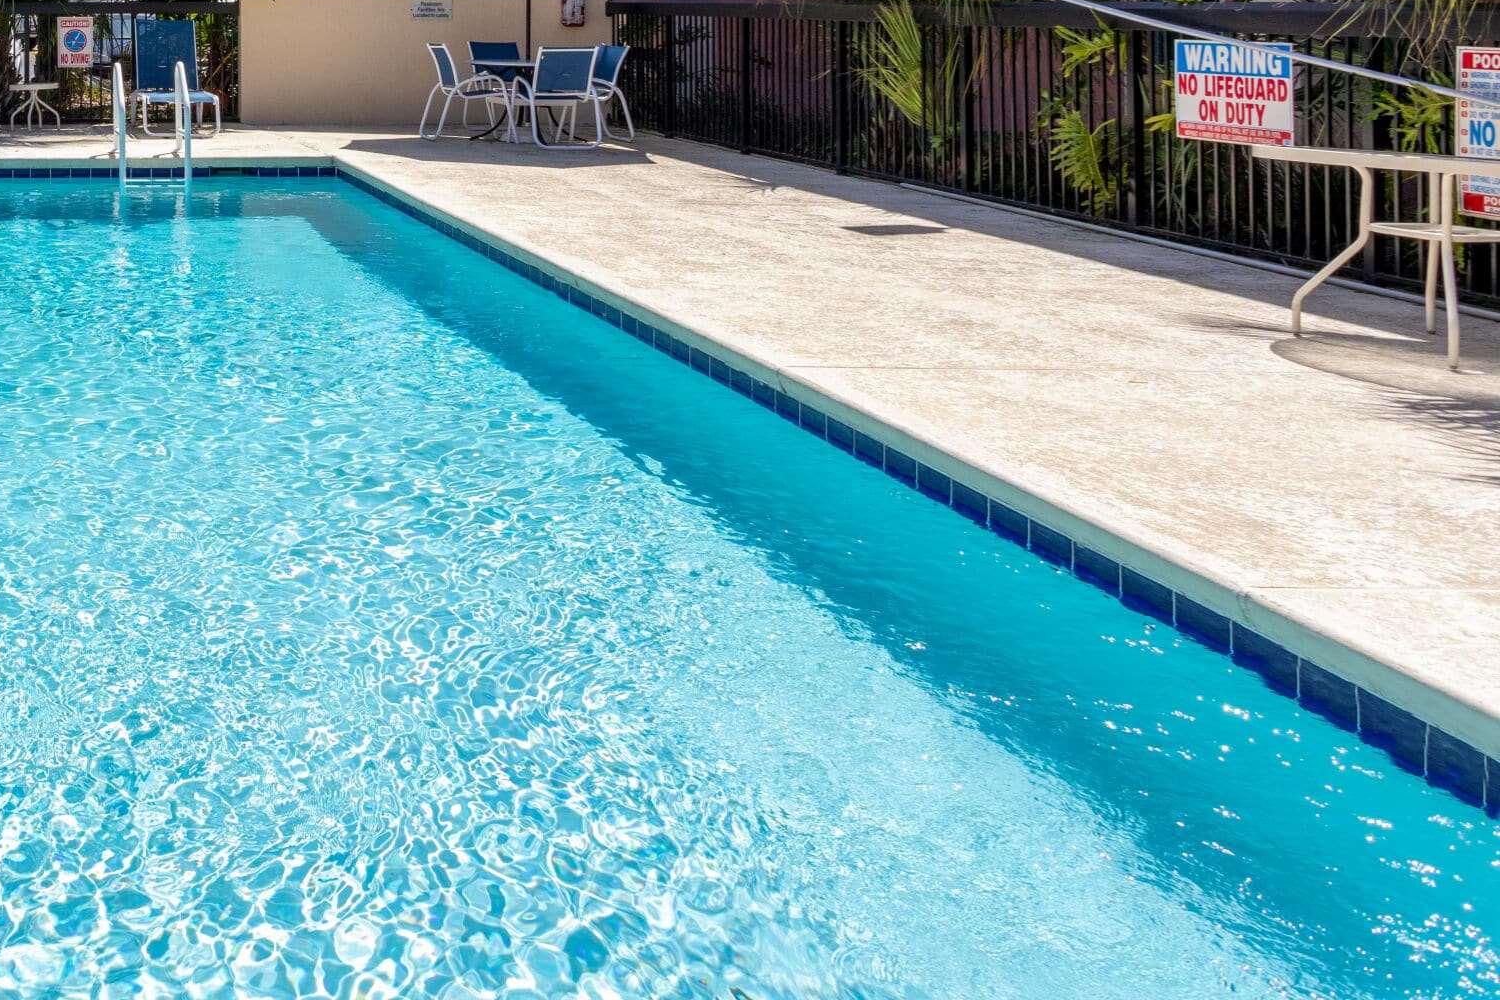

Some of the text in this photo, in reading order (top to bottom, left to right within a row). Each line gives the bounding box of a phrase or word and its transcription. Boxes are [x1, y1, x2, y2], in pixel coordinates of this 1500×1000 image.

[60, 53, 69, 65] NO
[1183, 44, 1282, 76] WARNING
[1178, 73, 1288, 103] NO LIFEGUARD
[1198, 99, 1266, 127] ON DUTY
[1469, 119, 1496, 147] NO
